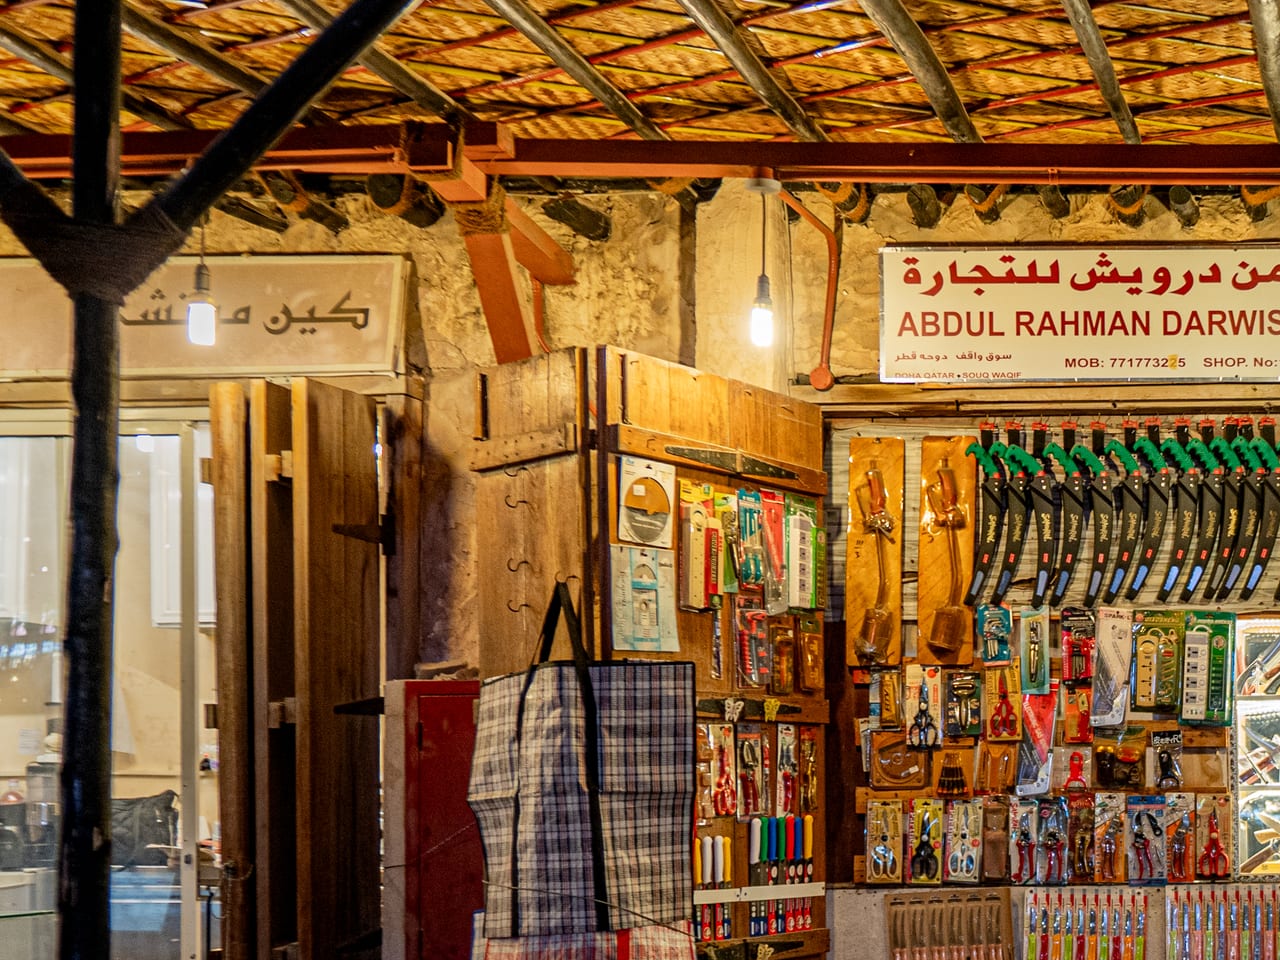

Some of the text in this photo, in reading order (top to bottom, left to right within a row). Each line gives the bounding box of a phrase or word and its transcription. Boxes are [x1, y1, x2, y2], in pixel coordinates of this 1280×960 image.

[902, 255, 1060, 296] للتجارة
[1070, 252, 1222, 296] درويش
[898, 311, 1004, 337] ABDUL
[1016, 310, 1150, 336] RAHMAN
[895, 352, 917, 362] قطر
[955, 351, 983, 362] واقف
[986, 353, 1012, 361] سوق
[1064, 358, 1104, 368] MOB:
[1203, 358, 1248, 367] SHOP.
